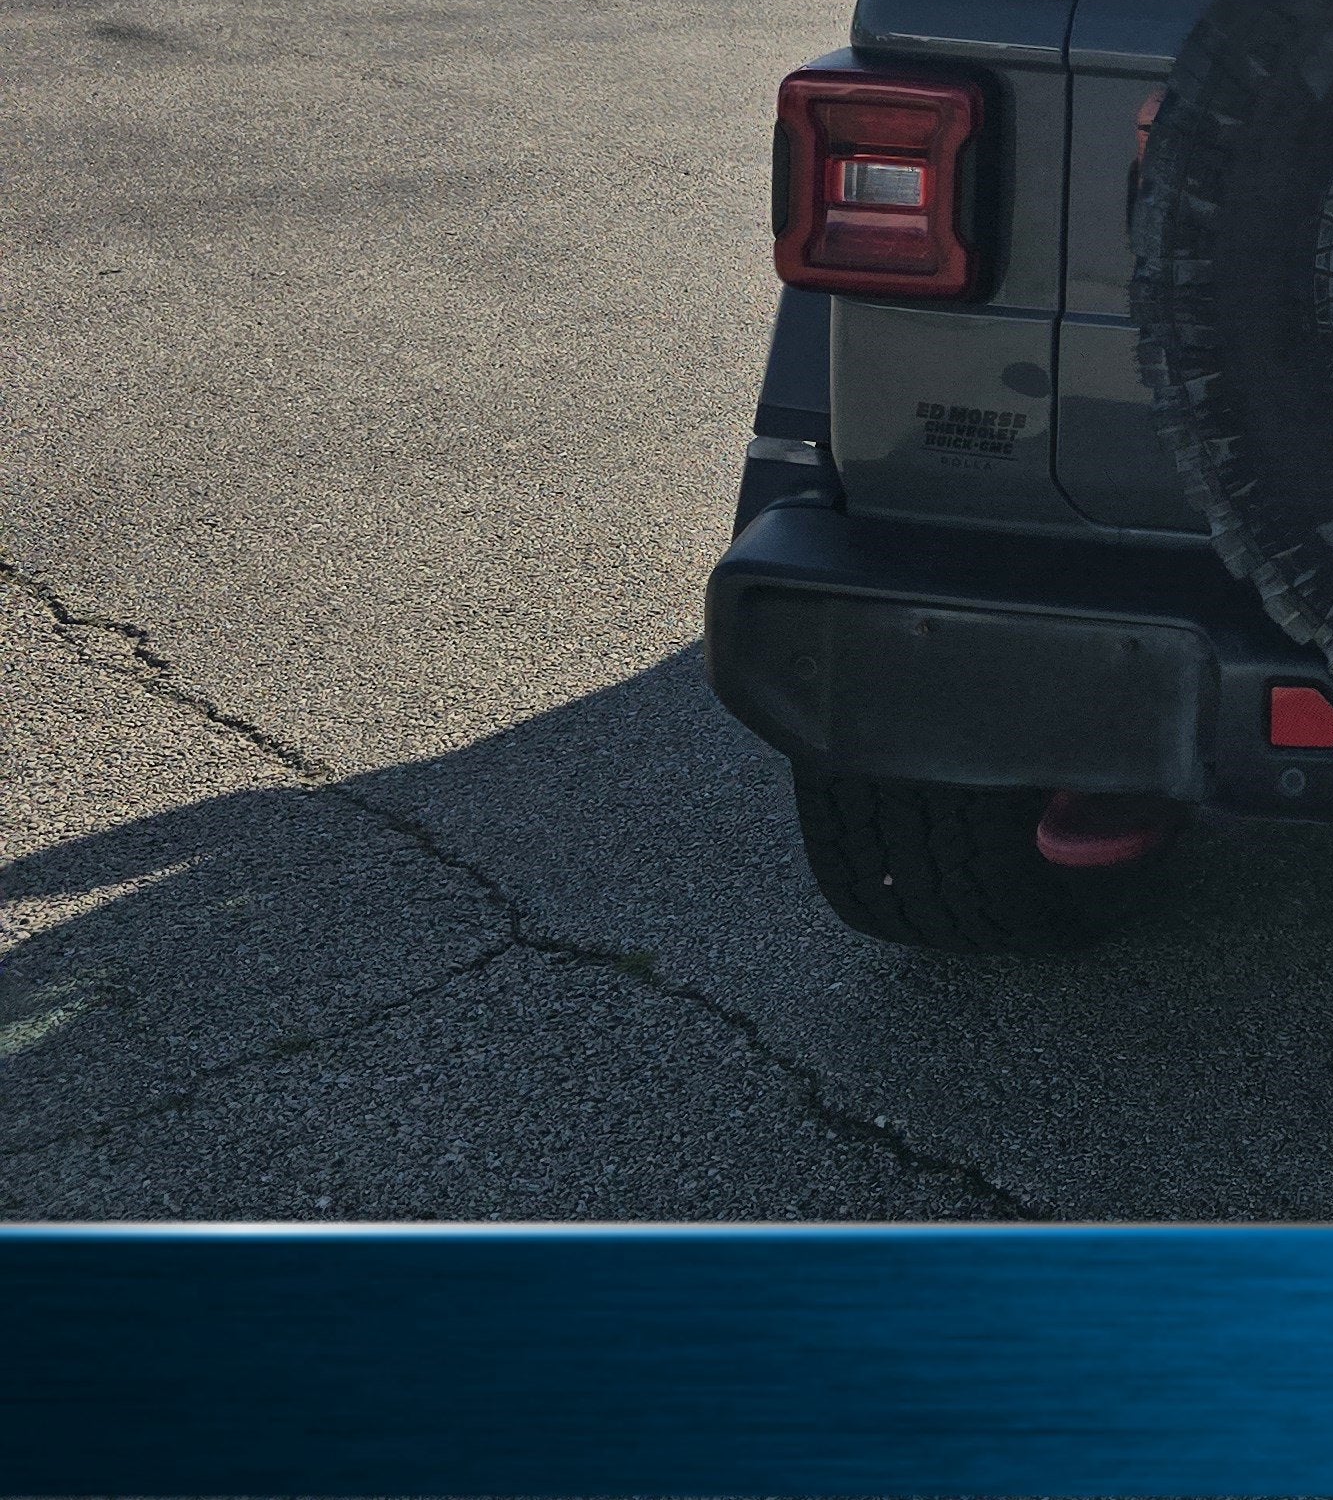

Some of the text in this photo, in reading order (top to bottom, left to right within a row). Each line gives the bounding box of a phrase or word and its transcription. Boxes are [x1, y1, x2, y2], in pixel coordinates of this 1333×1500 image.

[916, 401, 1027, 429] ED MORSE
[925, 421, 1019, 441] CHEVROLET
